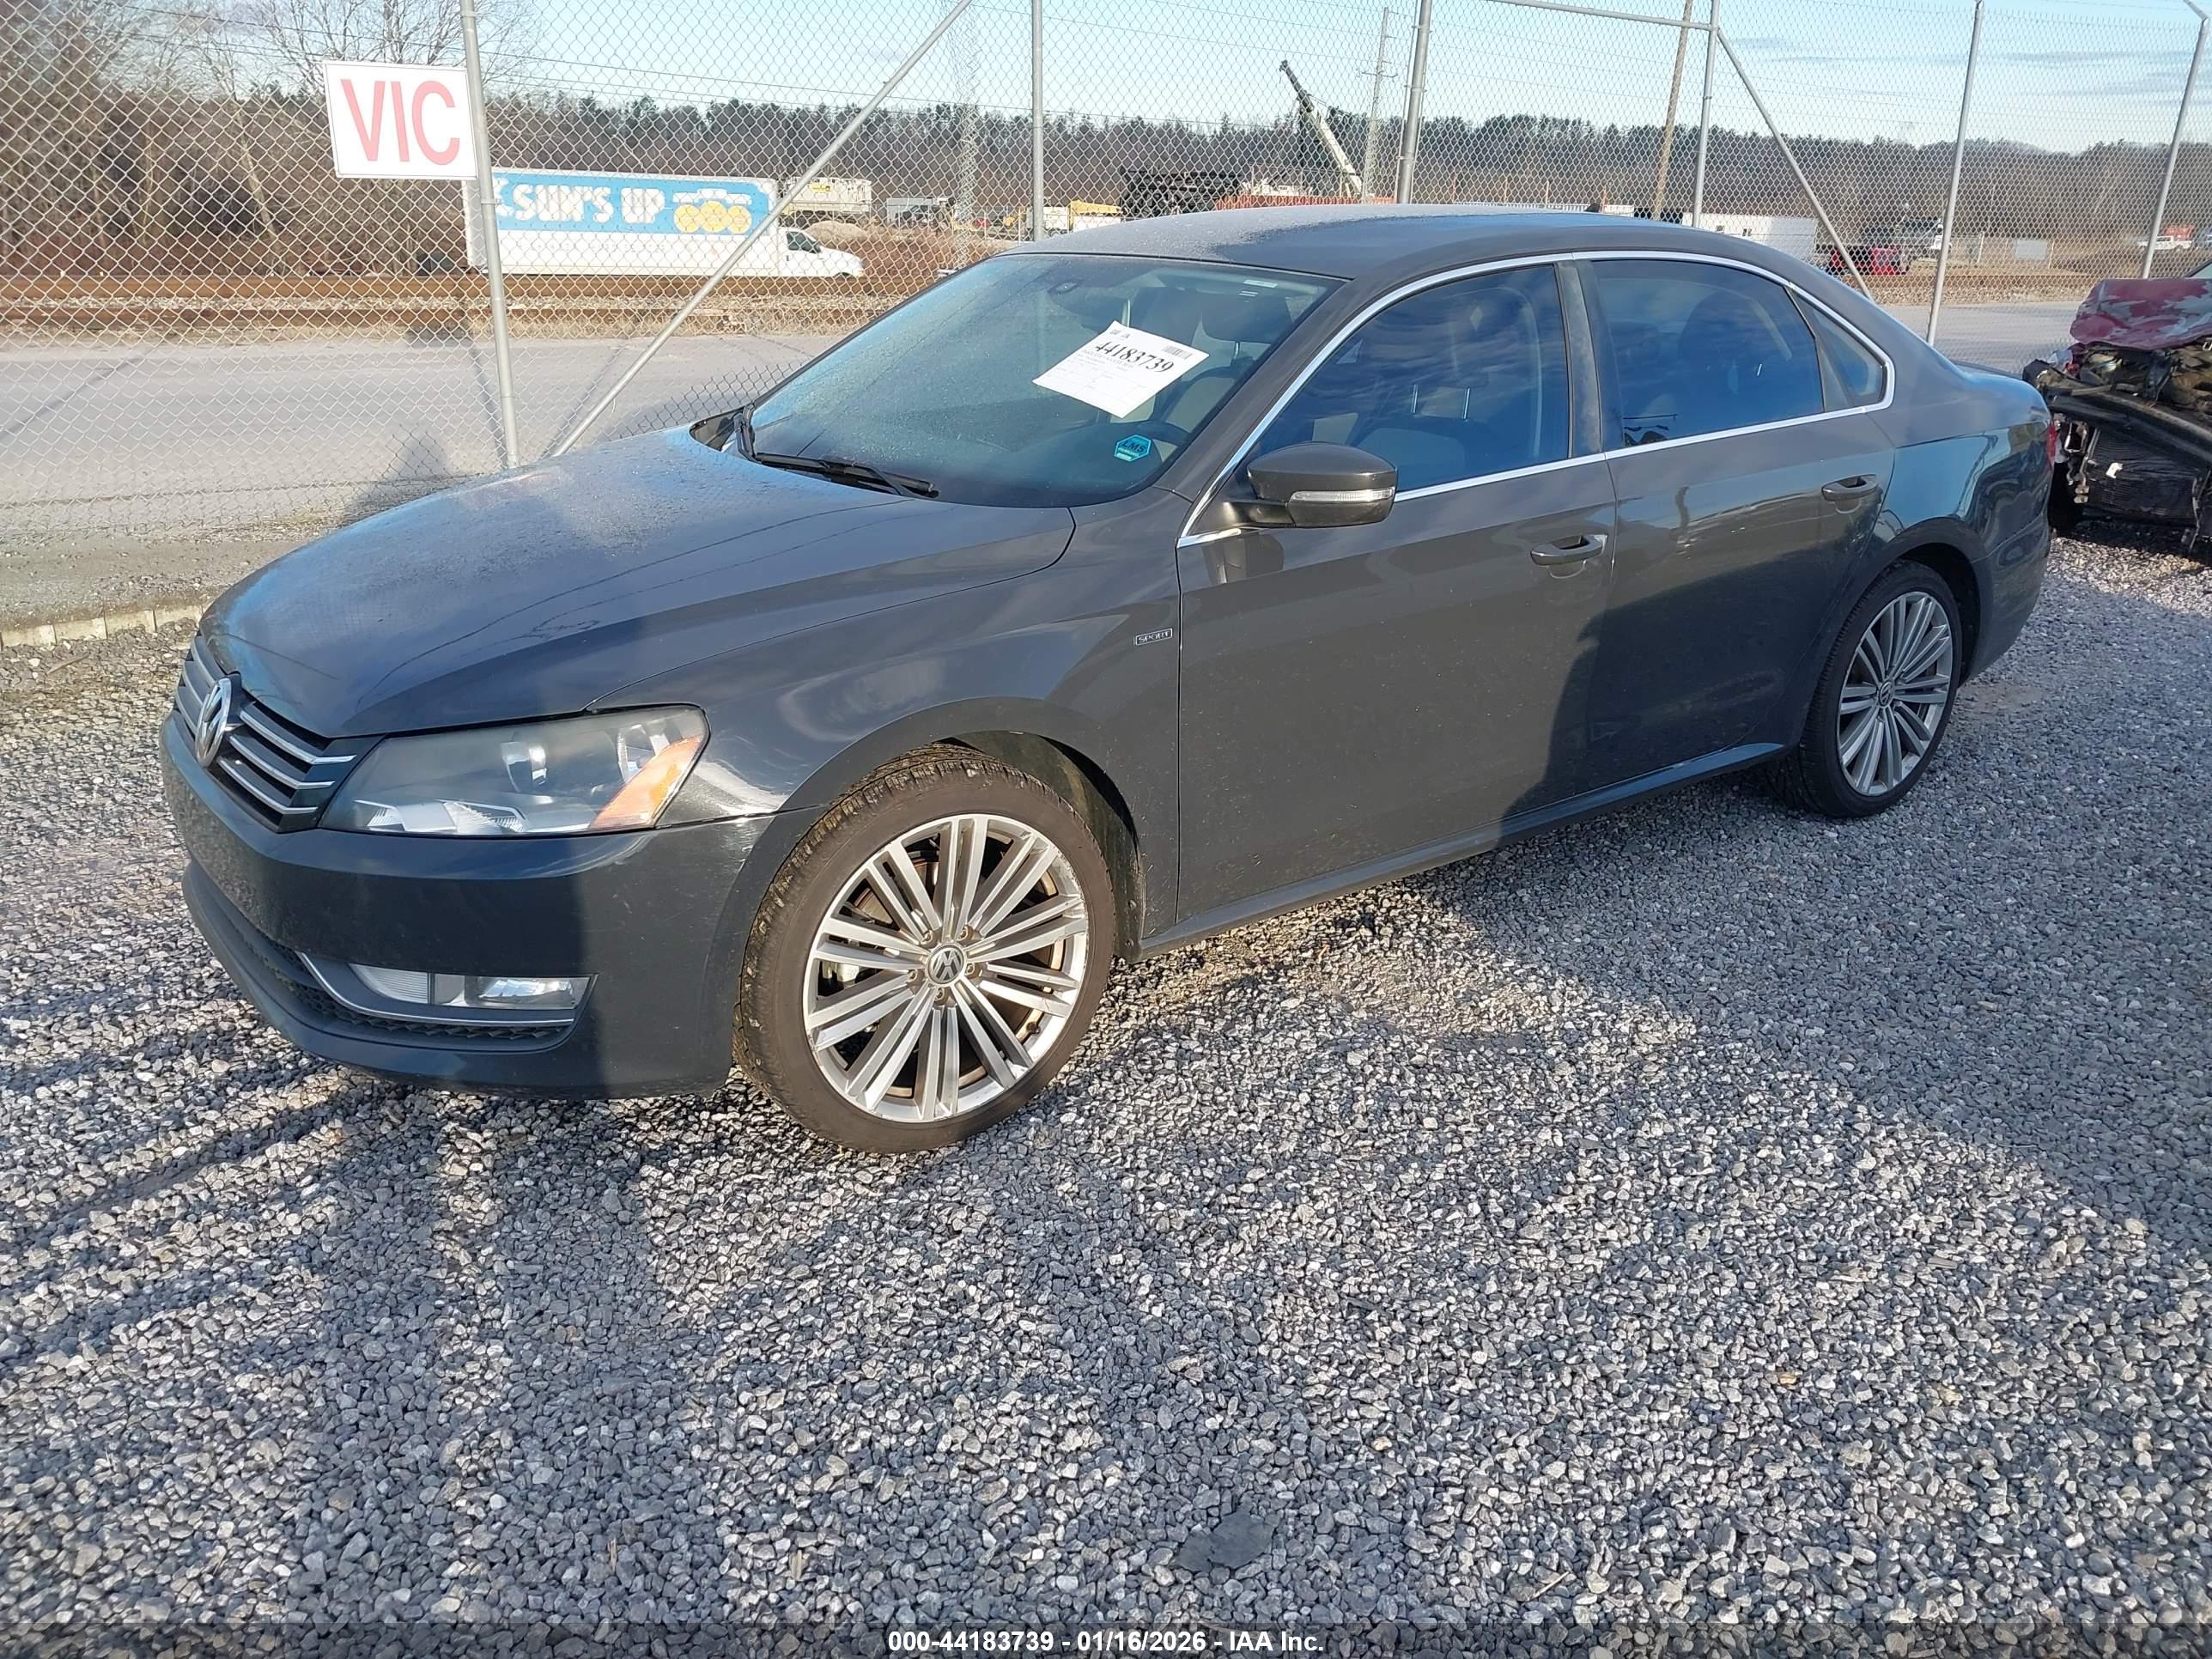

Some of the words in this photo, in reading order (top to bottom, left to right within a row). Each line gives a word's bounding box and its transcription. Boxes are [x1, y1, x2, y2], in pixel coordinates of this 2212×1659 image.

[340, 79, 460, 165] VIC
[513, 184, 614, 223] SUN'S
[621, 187, 665, 224] UP
[1095, 341, 1175, 373] 44183739
[1120, 440, 1146, 453] LMS
[1138, 630, 1170, 643] SPORT
